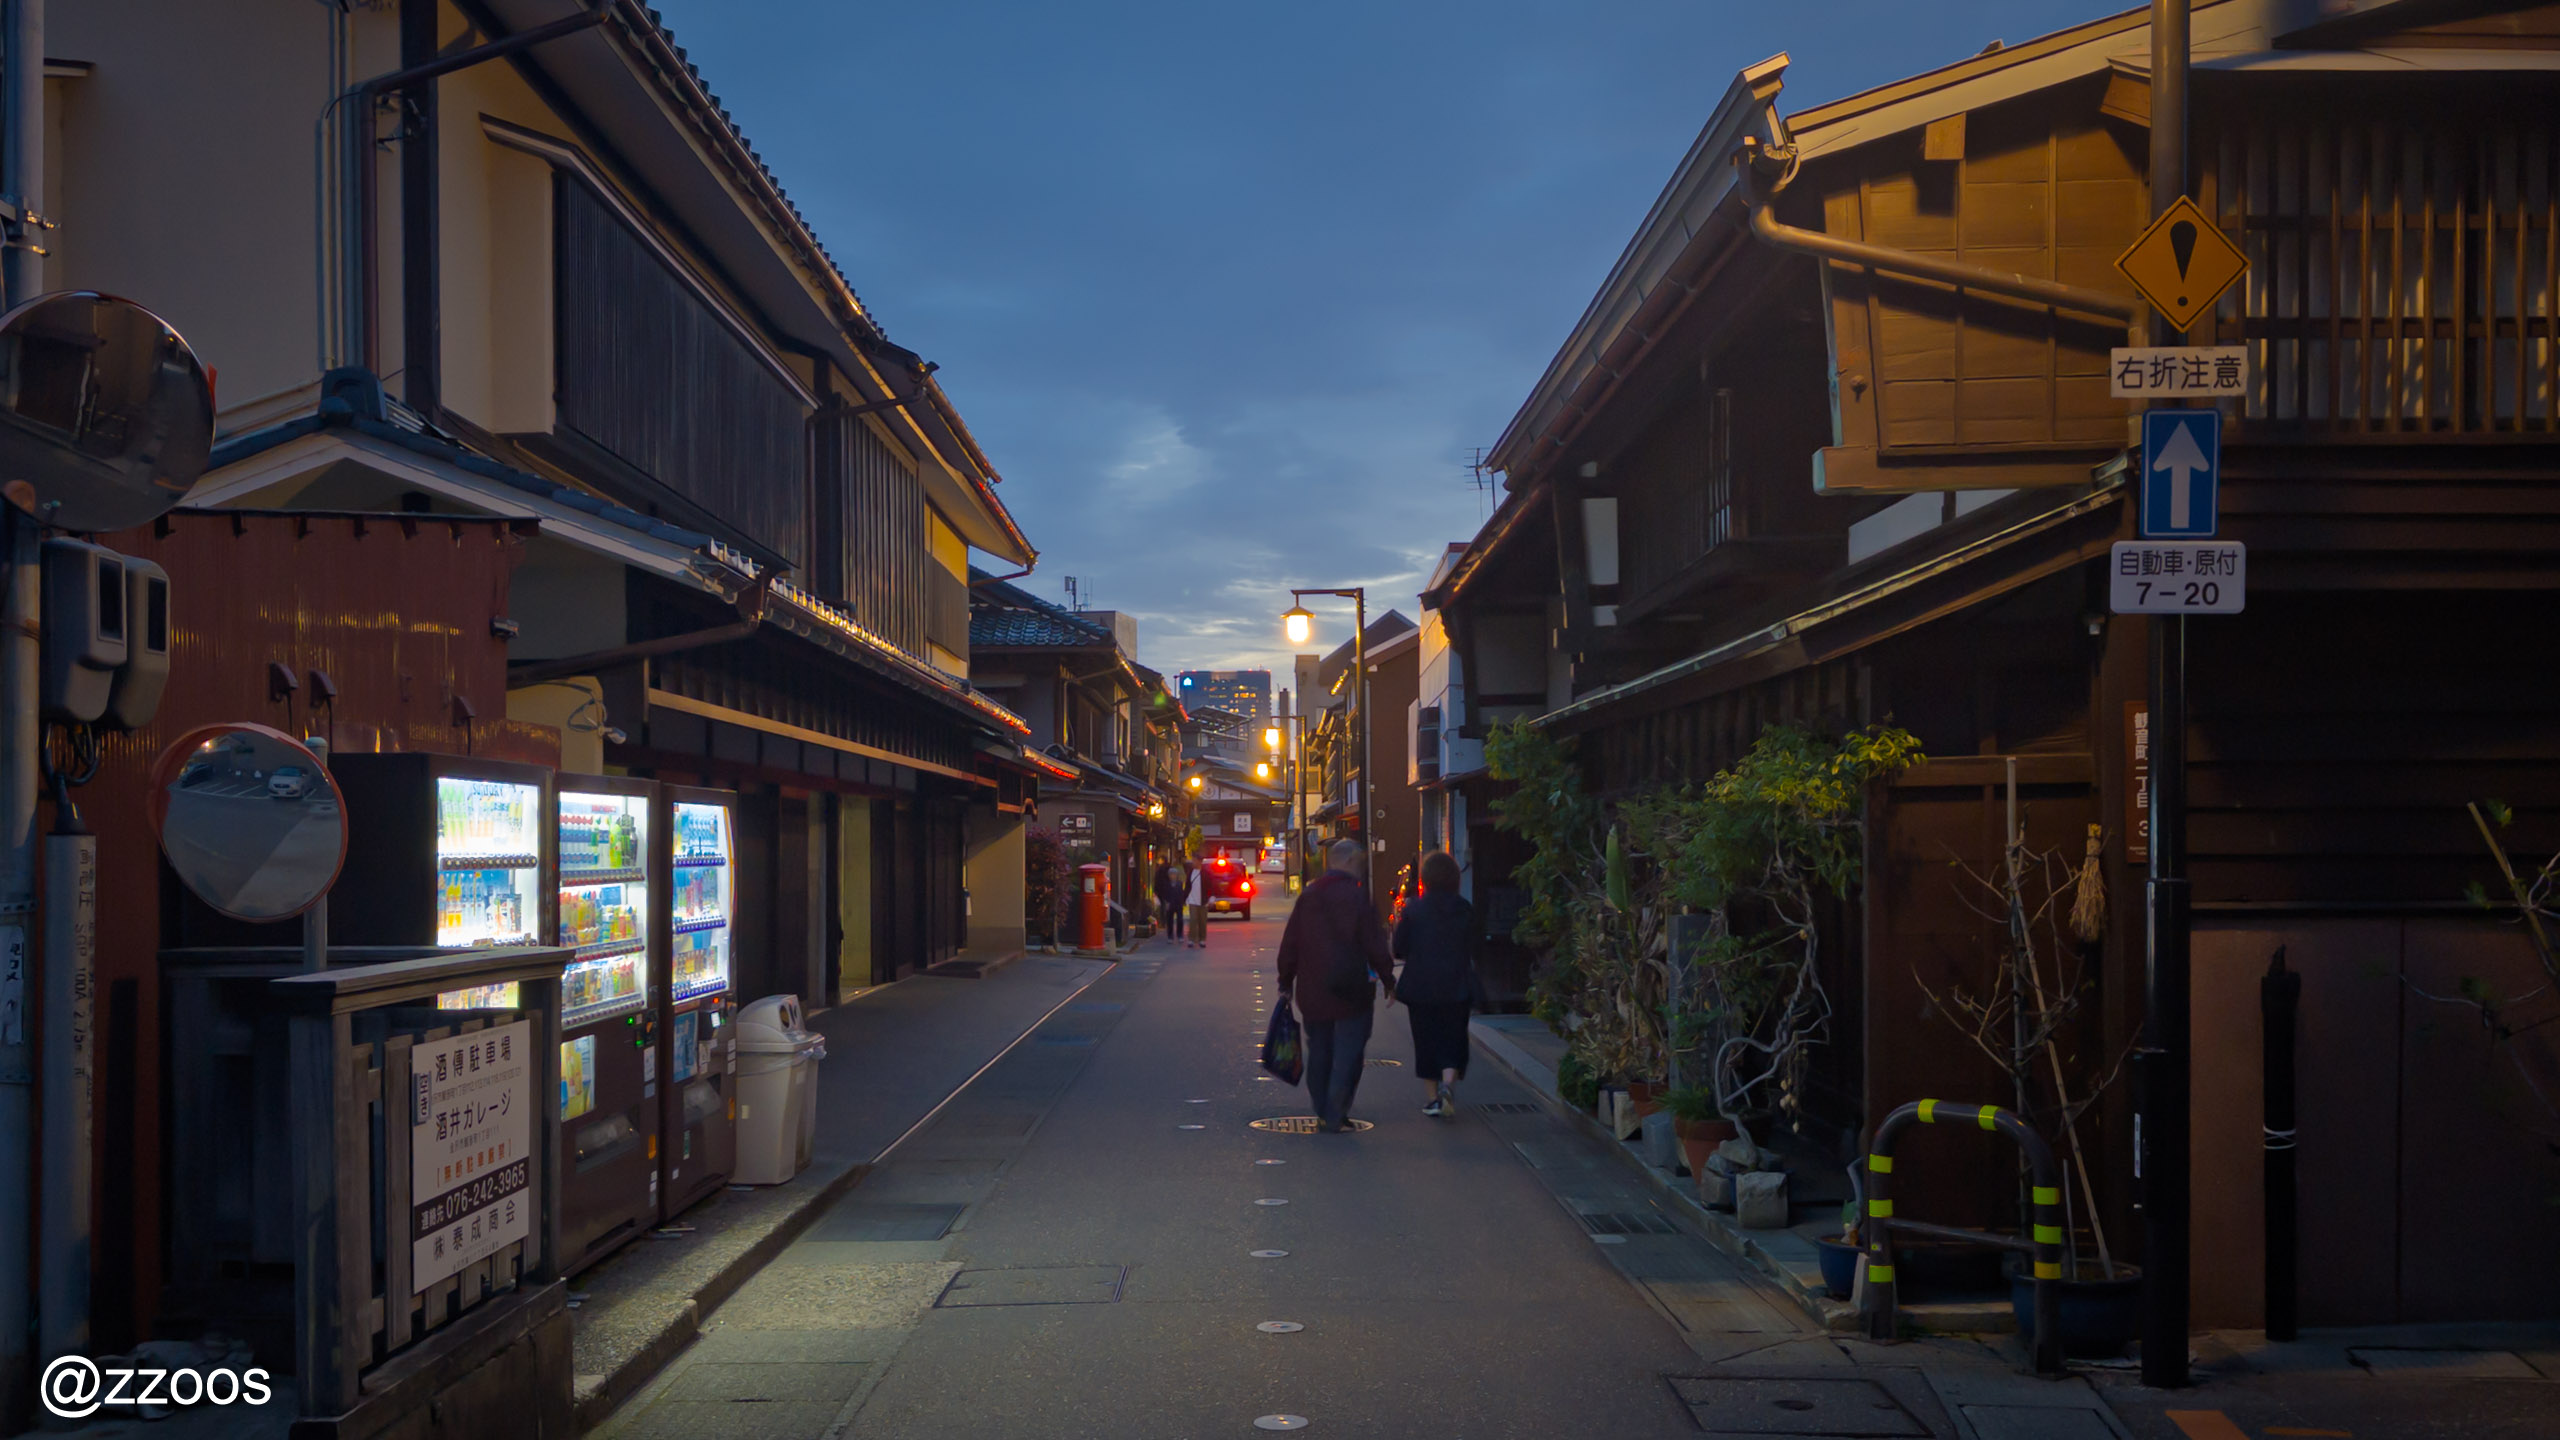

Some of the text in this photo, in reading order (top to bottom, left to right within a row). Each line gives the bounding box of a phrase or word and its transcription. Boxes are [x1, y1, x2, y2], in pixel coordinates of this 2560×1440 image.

[2116, 354, 2242, 391] 右折注意
[436, 1088, 511, 1142] 酒井ガレージ
[421, 1162, 525, 1230] 連絡先 076-242-3965
